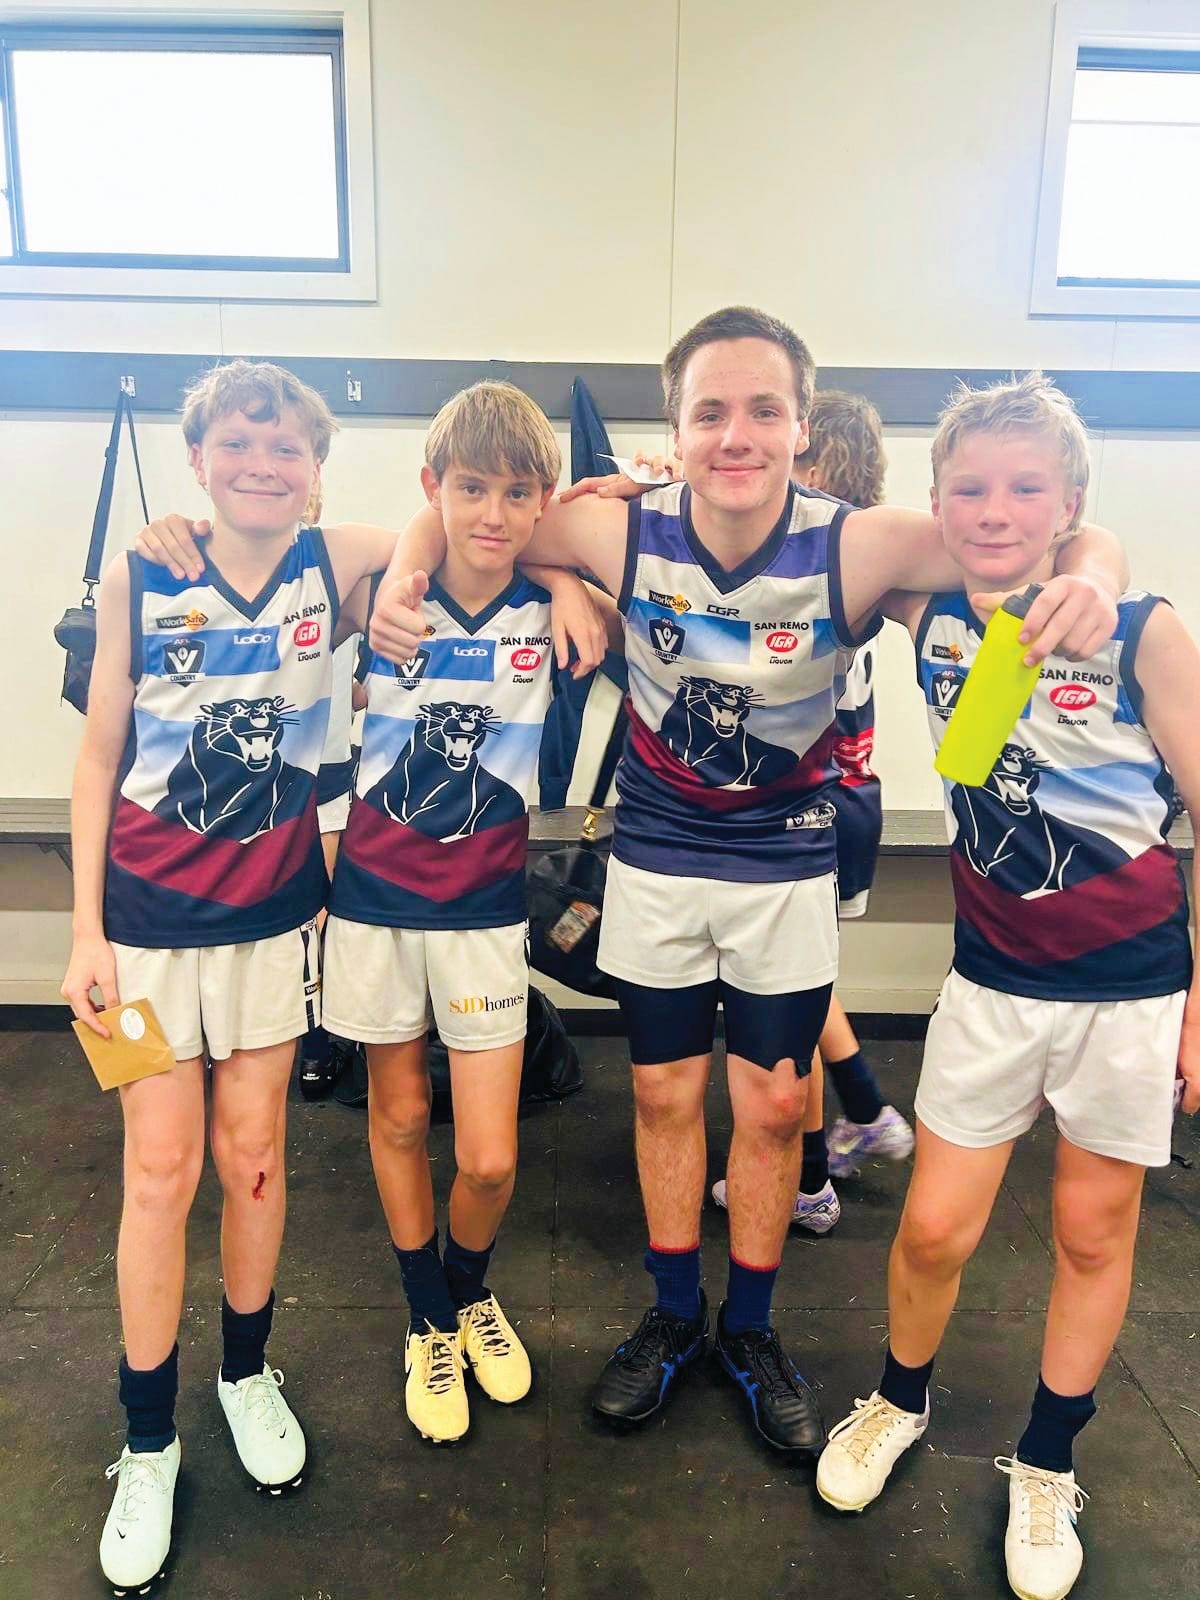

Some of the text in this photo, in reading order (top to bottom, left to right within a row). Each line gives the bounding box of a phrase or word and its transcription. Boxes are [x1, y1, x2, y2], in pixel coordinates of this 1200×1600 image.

[282, 603, 326, 625] AN EMO
[706, 604, 740, 618] CGR
[754, 621, 810, 631] SAN REMO
[295, 624, 318, 643] IGA
[500, 636, 552, 646] SAN REMO
[769, 636, 796, 649] IGA
[513, 653, 539, 666] IGA
[654, 649, 678, 661] COUNTRY
[169, 674, 197, 682] COUNTRY
[1038, 668, 1114, 686] SAN REMO
[1054, 689, 1093, 705] IGA
[1057, 717, 1088, 726] LIQUOR
